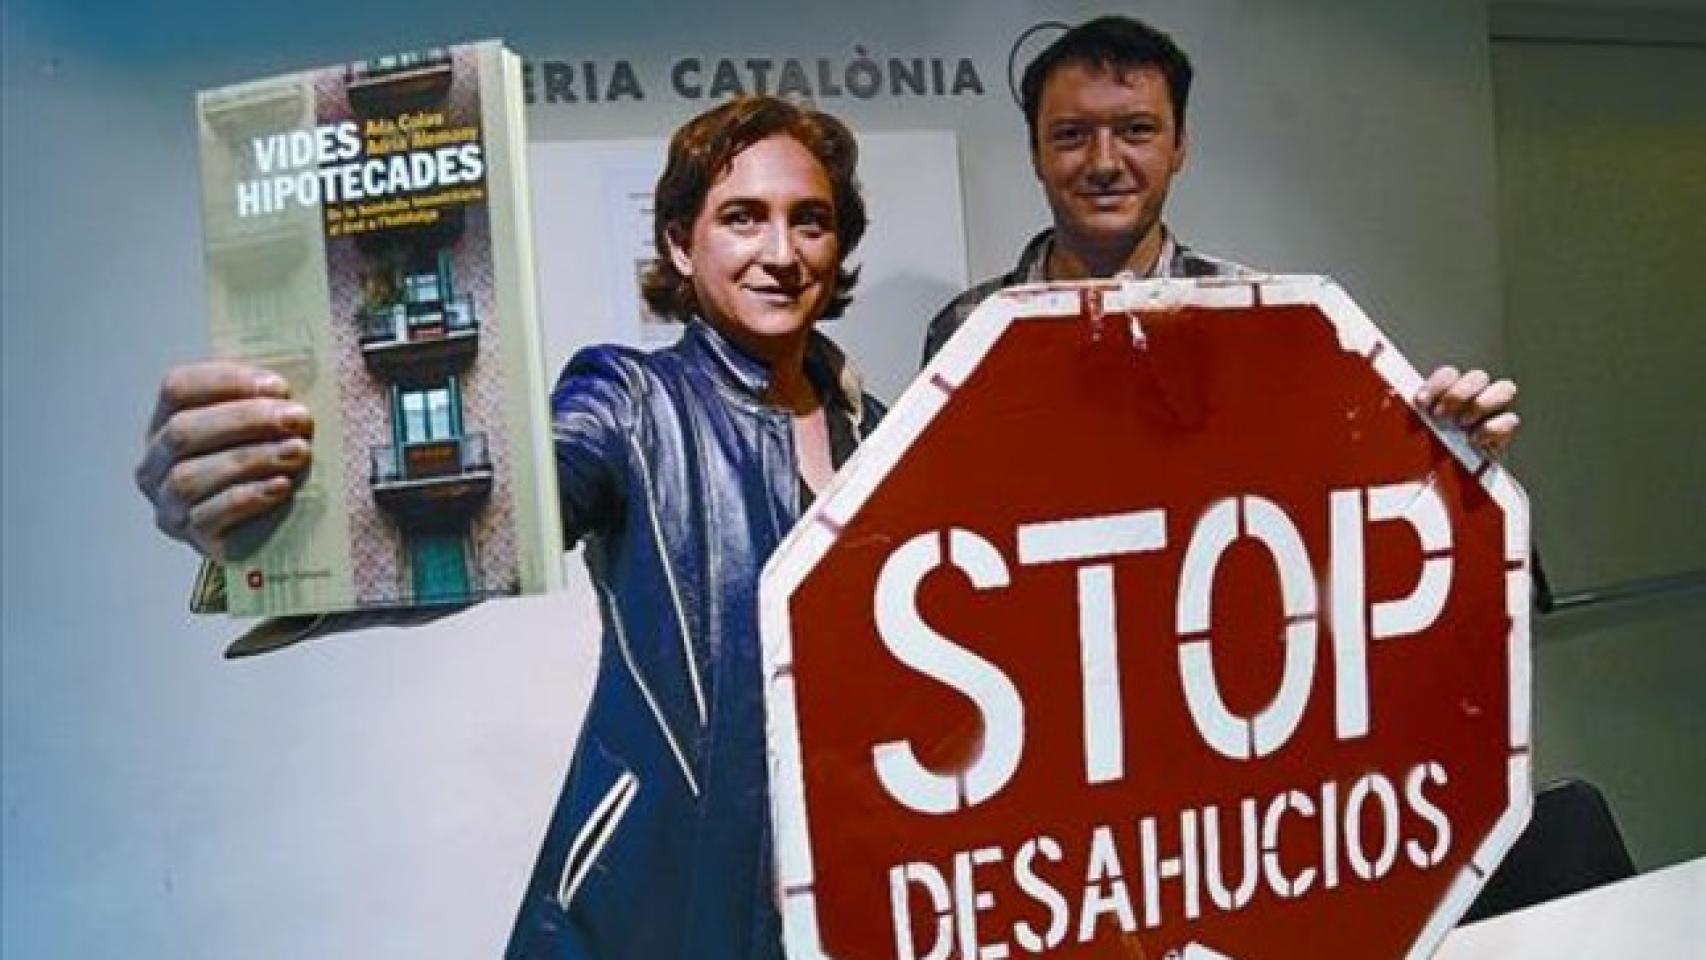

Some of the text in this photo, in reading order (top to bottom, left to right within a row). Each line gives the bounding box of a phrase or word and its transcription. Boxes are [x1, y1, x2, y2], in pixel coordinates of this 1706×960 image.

[671, 46, 985, 99] CATALÒNIA
[237, 143, 484, 218] HIPOTECADES
[253, 122, 362, 173] VIDES
[873, 480, 1454, 816] STOP
[889, 762, 1453, 960] DESAHUCIOS
